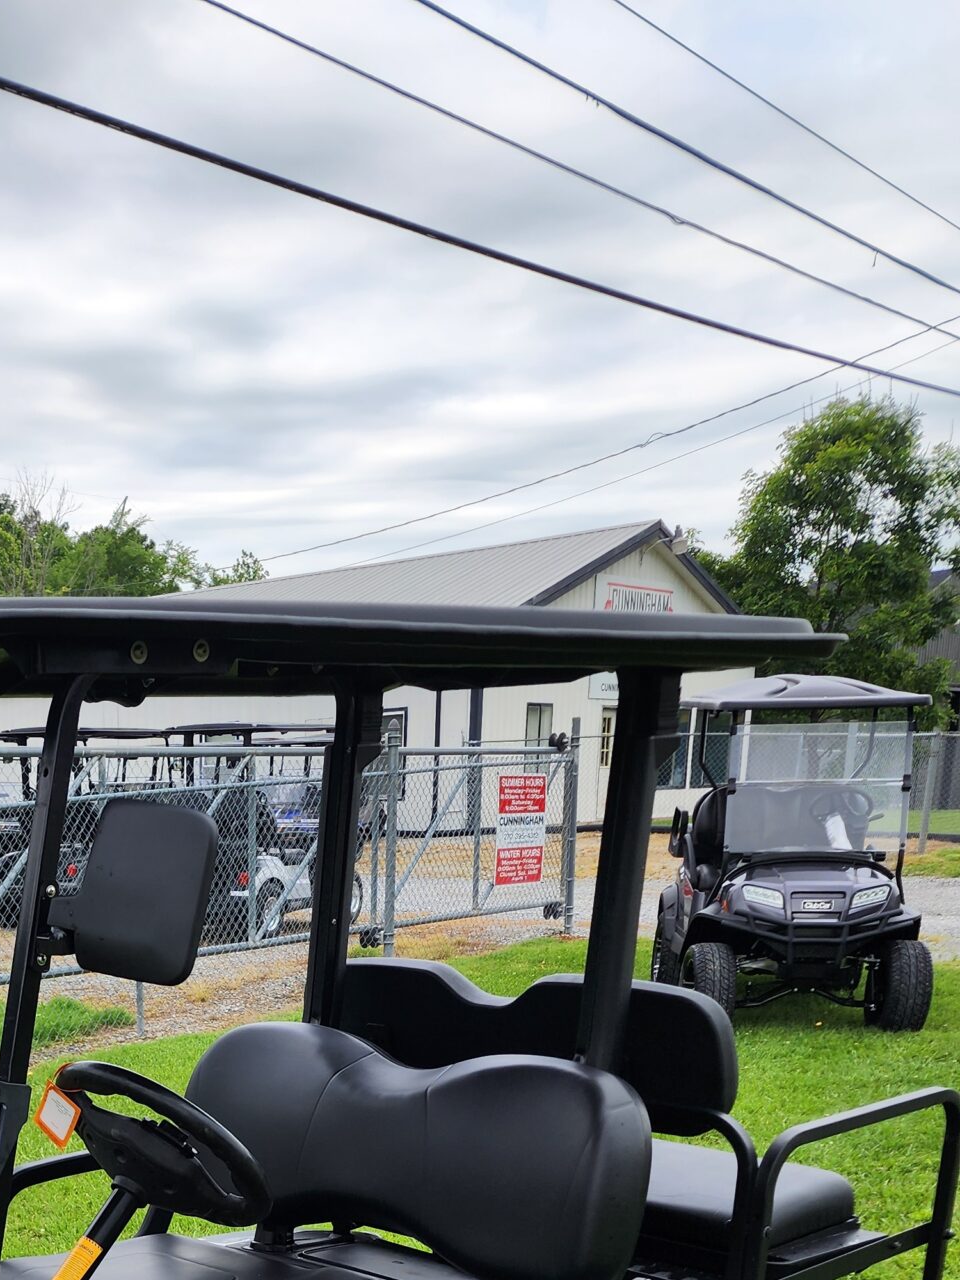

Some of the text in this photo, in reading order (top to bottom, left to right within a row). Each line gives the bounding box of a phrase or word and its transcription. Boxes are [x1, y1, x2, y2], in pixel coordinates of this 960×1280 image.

[612, 587, 670, 613] CUNNINGHAM
[525, 777, 544, 787] HOURS
[500, 815, 544, 826] CUNNINGHAM
[521, 847, 541, 858] HOURS
